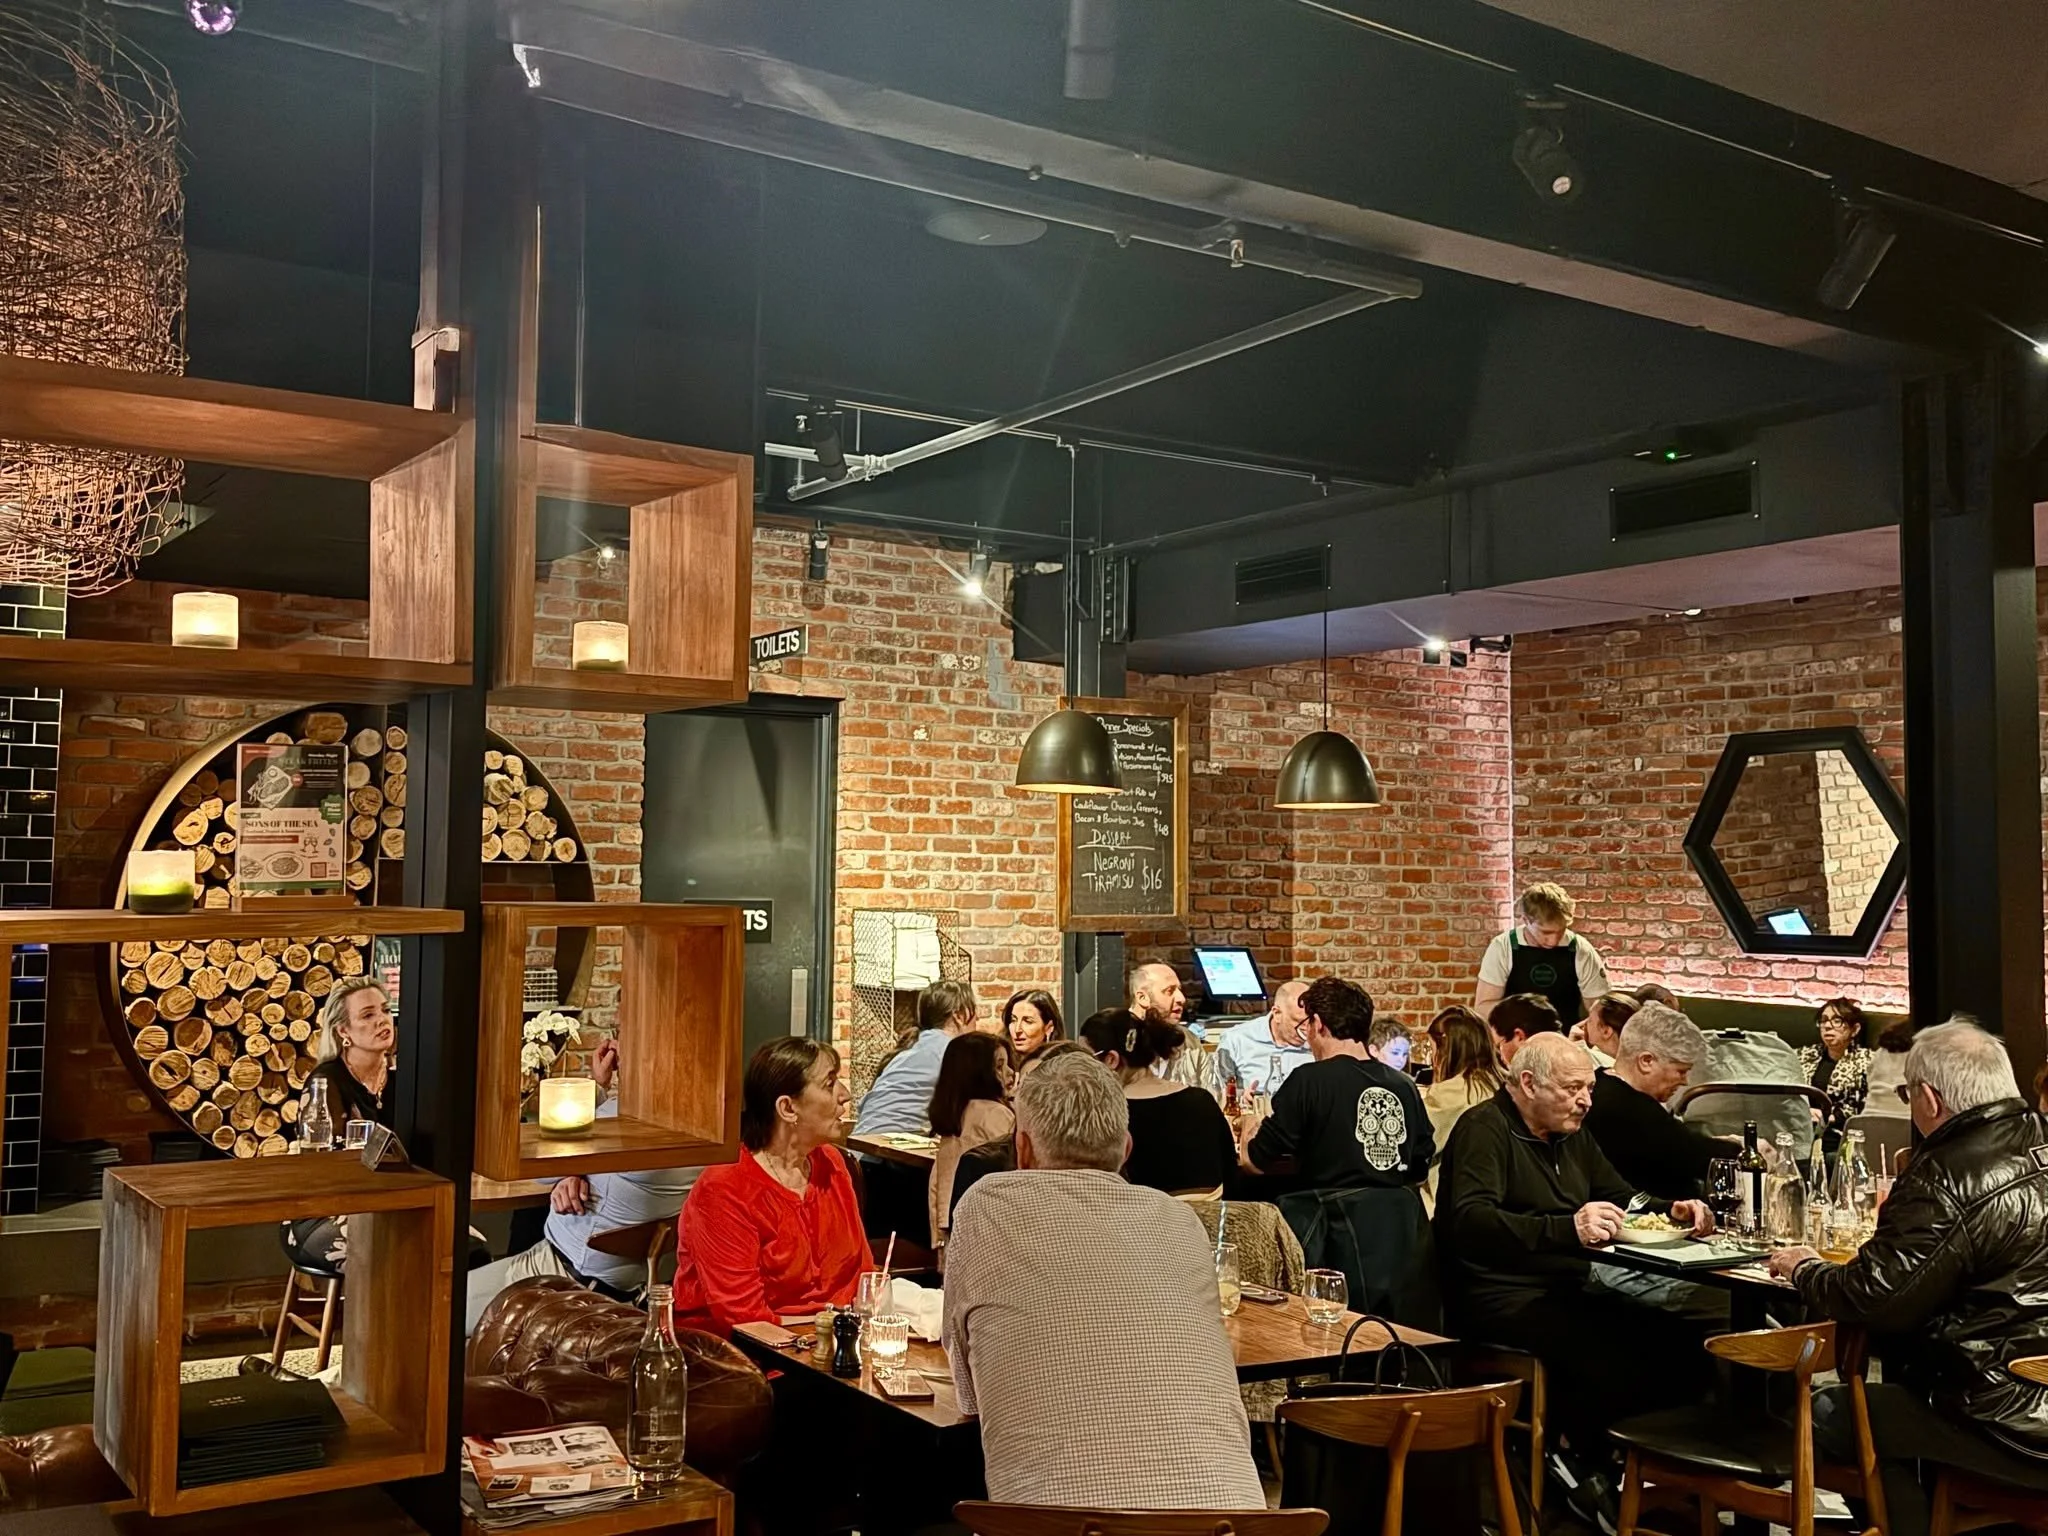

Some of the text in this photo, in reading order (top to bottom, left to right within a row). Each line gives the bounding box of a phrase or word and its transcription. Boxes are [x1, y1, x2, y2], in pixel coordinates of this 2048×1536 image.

[754, 630, 800, 659] TOILETS
[1123, 718, 1152, 735] Specials
[246, 820, 318, 828] SONS OF THE SEA
[1074, 812, 1095, 823] Bacon
[1102, 812, 1131, 825] Bourbon
[1153, 817, 1170, 836] $48
[1141, 858, 1162, 896] $16
